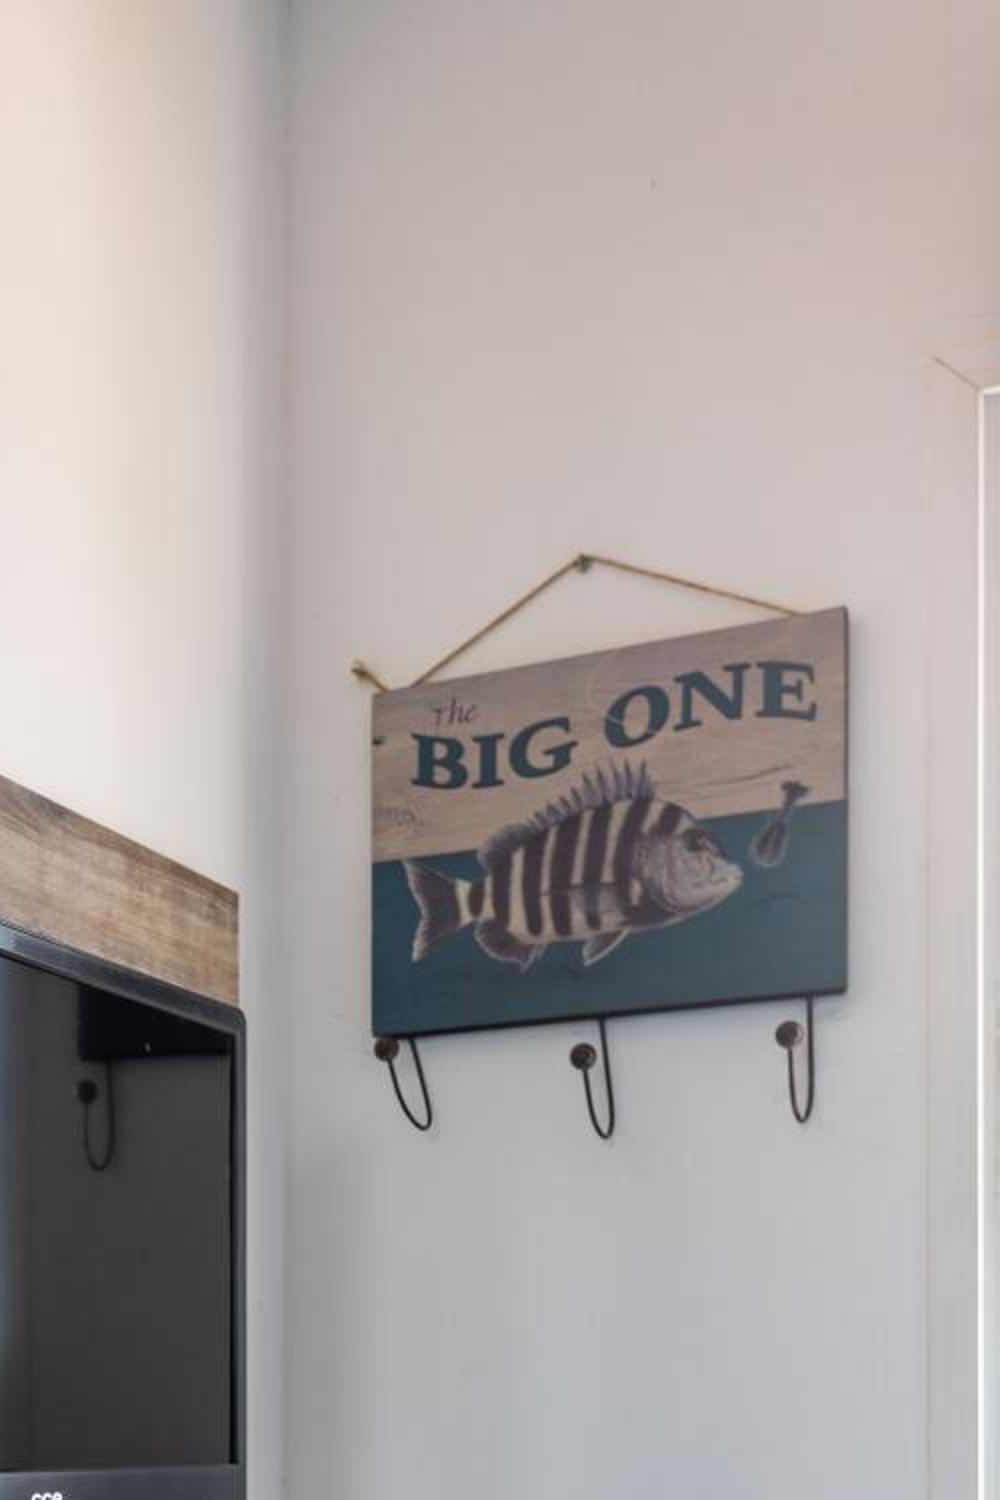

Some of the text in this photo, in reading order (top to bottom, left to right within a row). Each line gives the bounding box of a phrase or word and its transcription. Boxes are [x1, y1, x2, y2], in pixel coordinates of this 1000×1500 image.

[411, 661, 818, 790] BIG ONE
[432, 697, 478, 726] The
